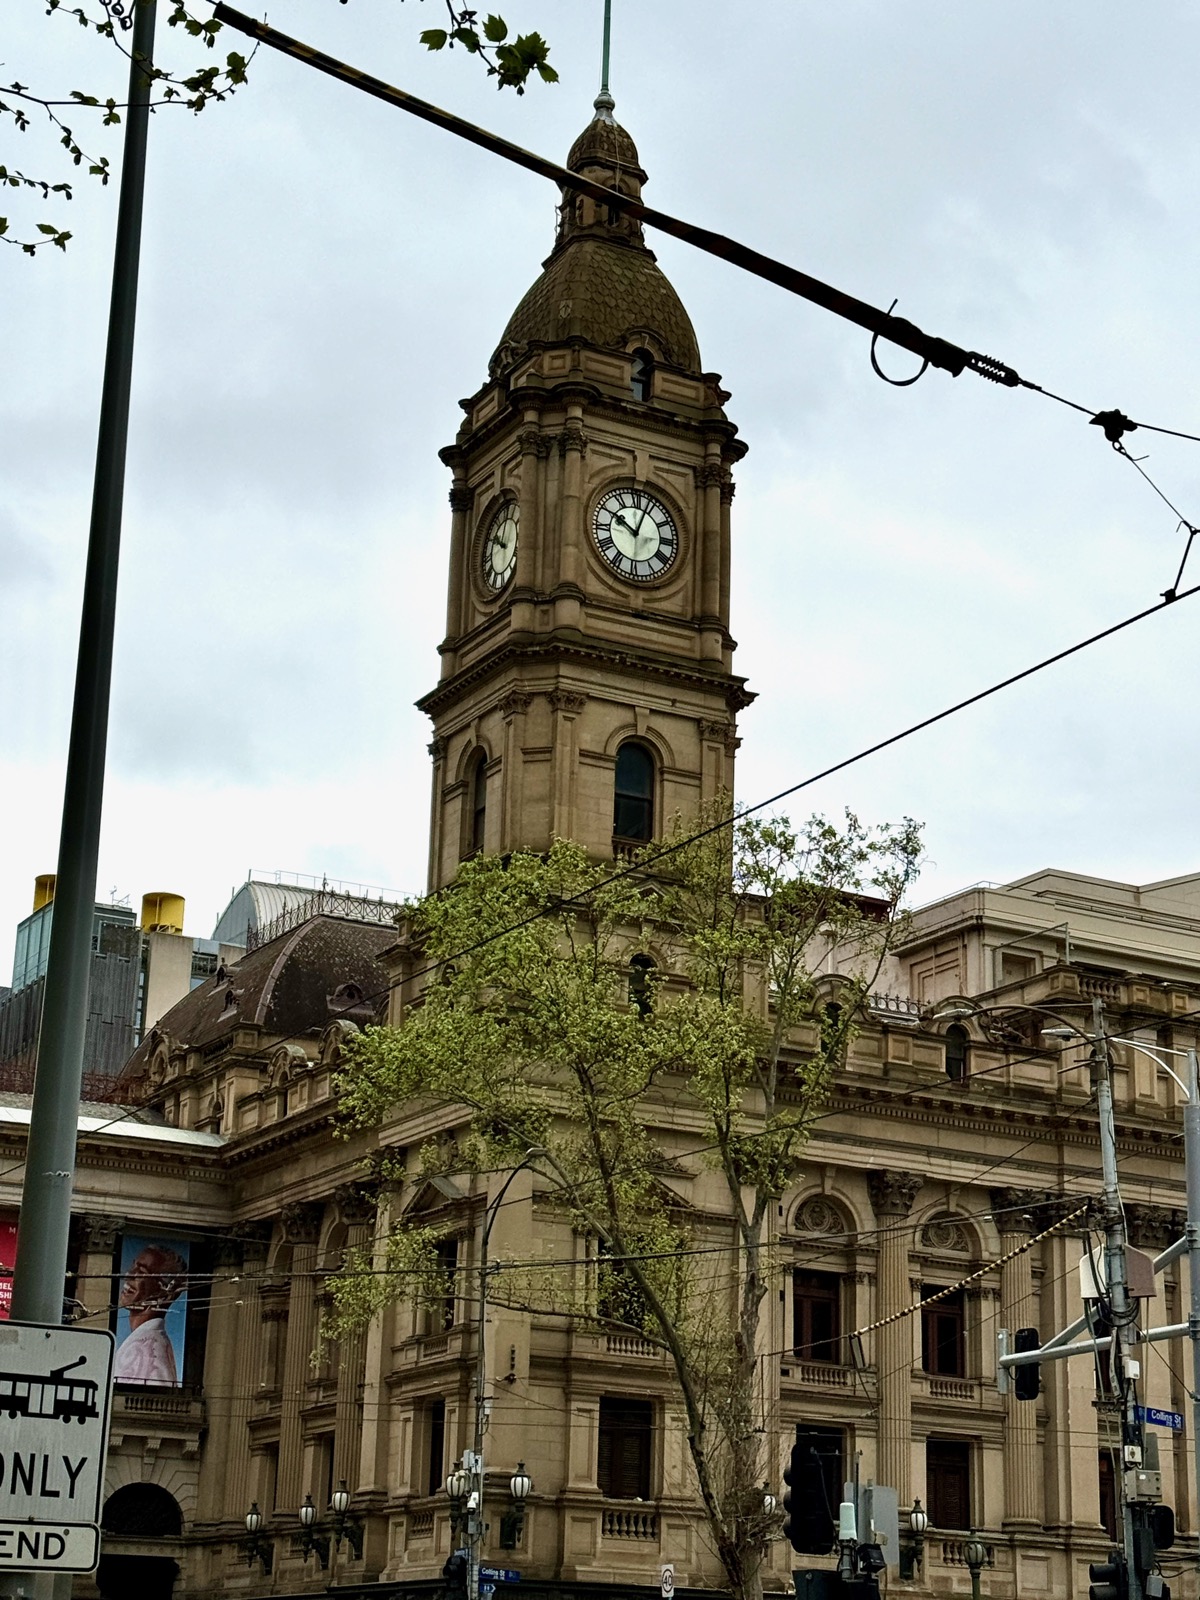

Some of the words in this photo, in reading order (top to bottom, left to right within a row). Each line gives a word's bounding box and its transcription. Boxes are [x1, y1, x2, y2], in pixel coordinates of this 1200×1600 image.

[657, 520, 669, 528] II
[660, 537, 673, 546] III
[1151, 1410, 1173, 1422] Collins
[0, 1452, 88, 1499] NLY
[0, 1530, 66, 1560] END
[481, 1567, 499, 1576] Collins
[663, 1574, 672, 1587] 40
